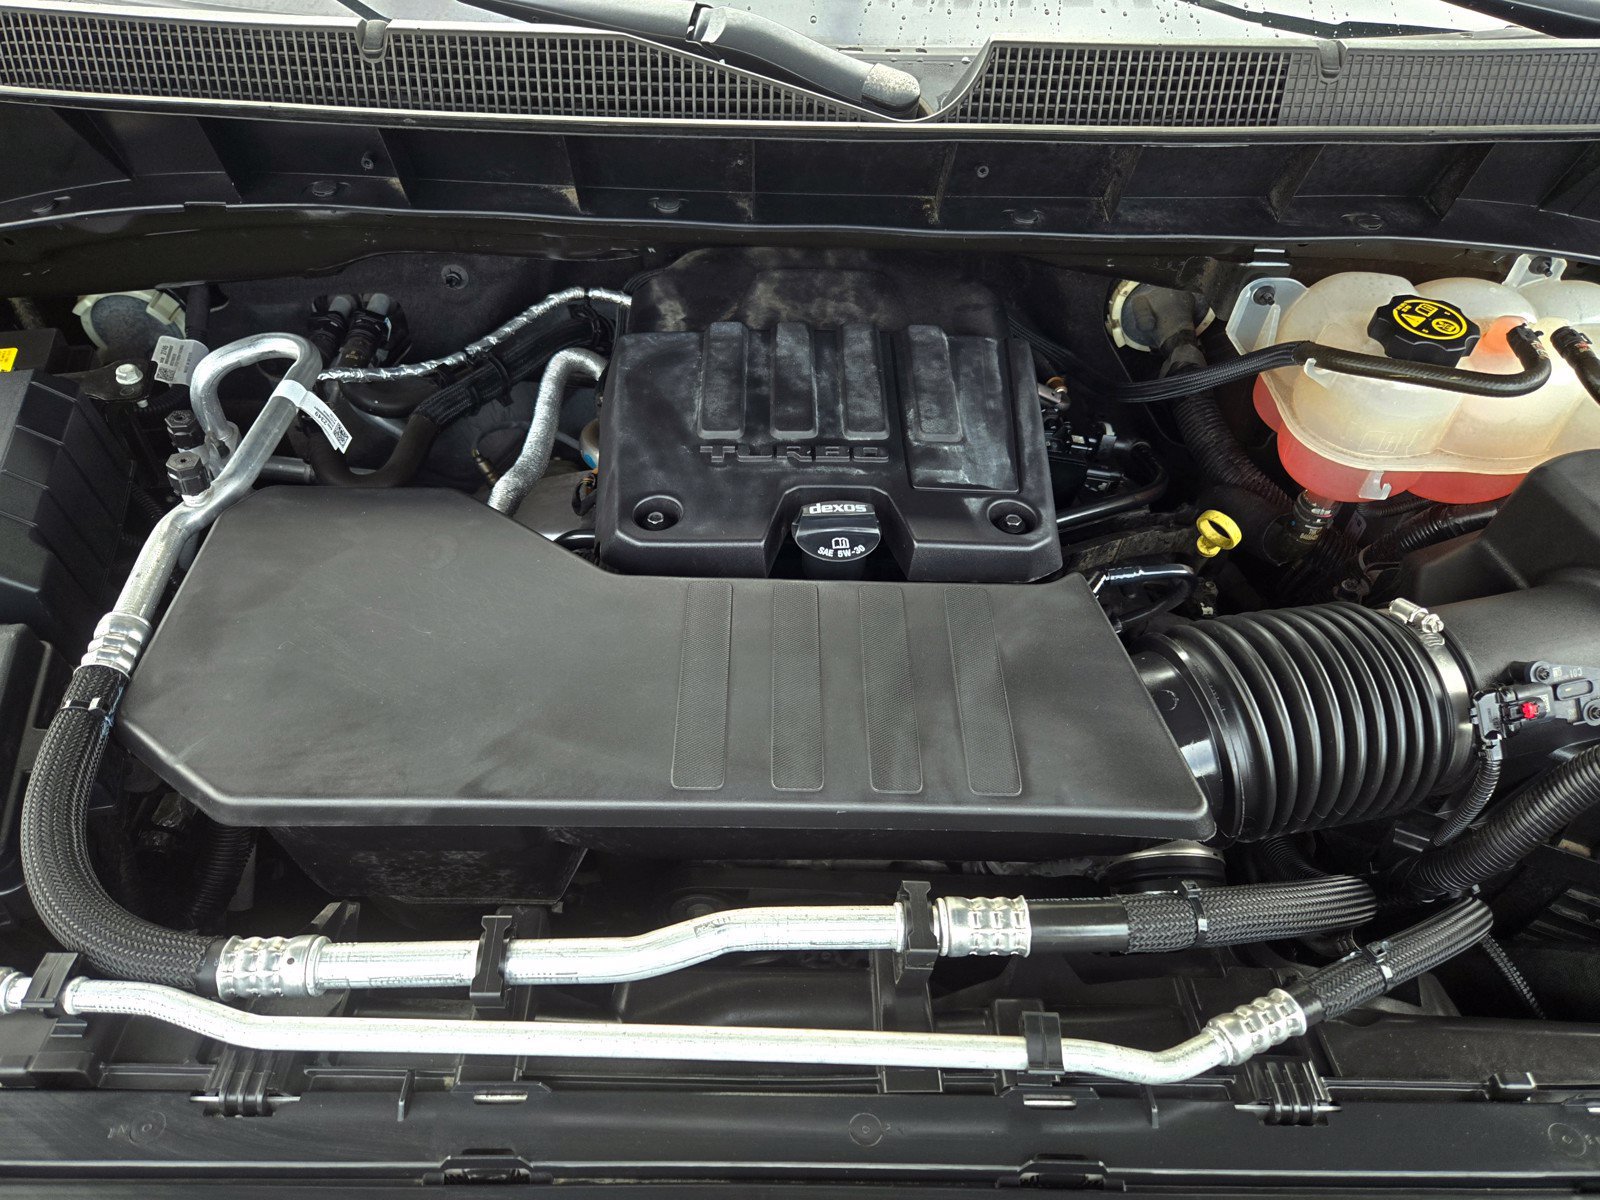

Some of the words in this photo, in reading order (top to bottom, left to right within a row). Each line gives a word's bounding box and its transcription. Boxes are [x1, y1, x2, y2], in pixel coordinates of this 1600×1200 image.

[699, 445, 890, 463] TURBO
[809, 503, 867, 514] dexos
[817, 546, 835, 558] SAE
[837, 544, 866, 558] 5W-30
